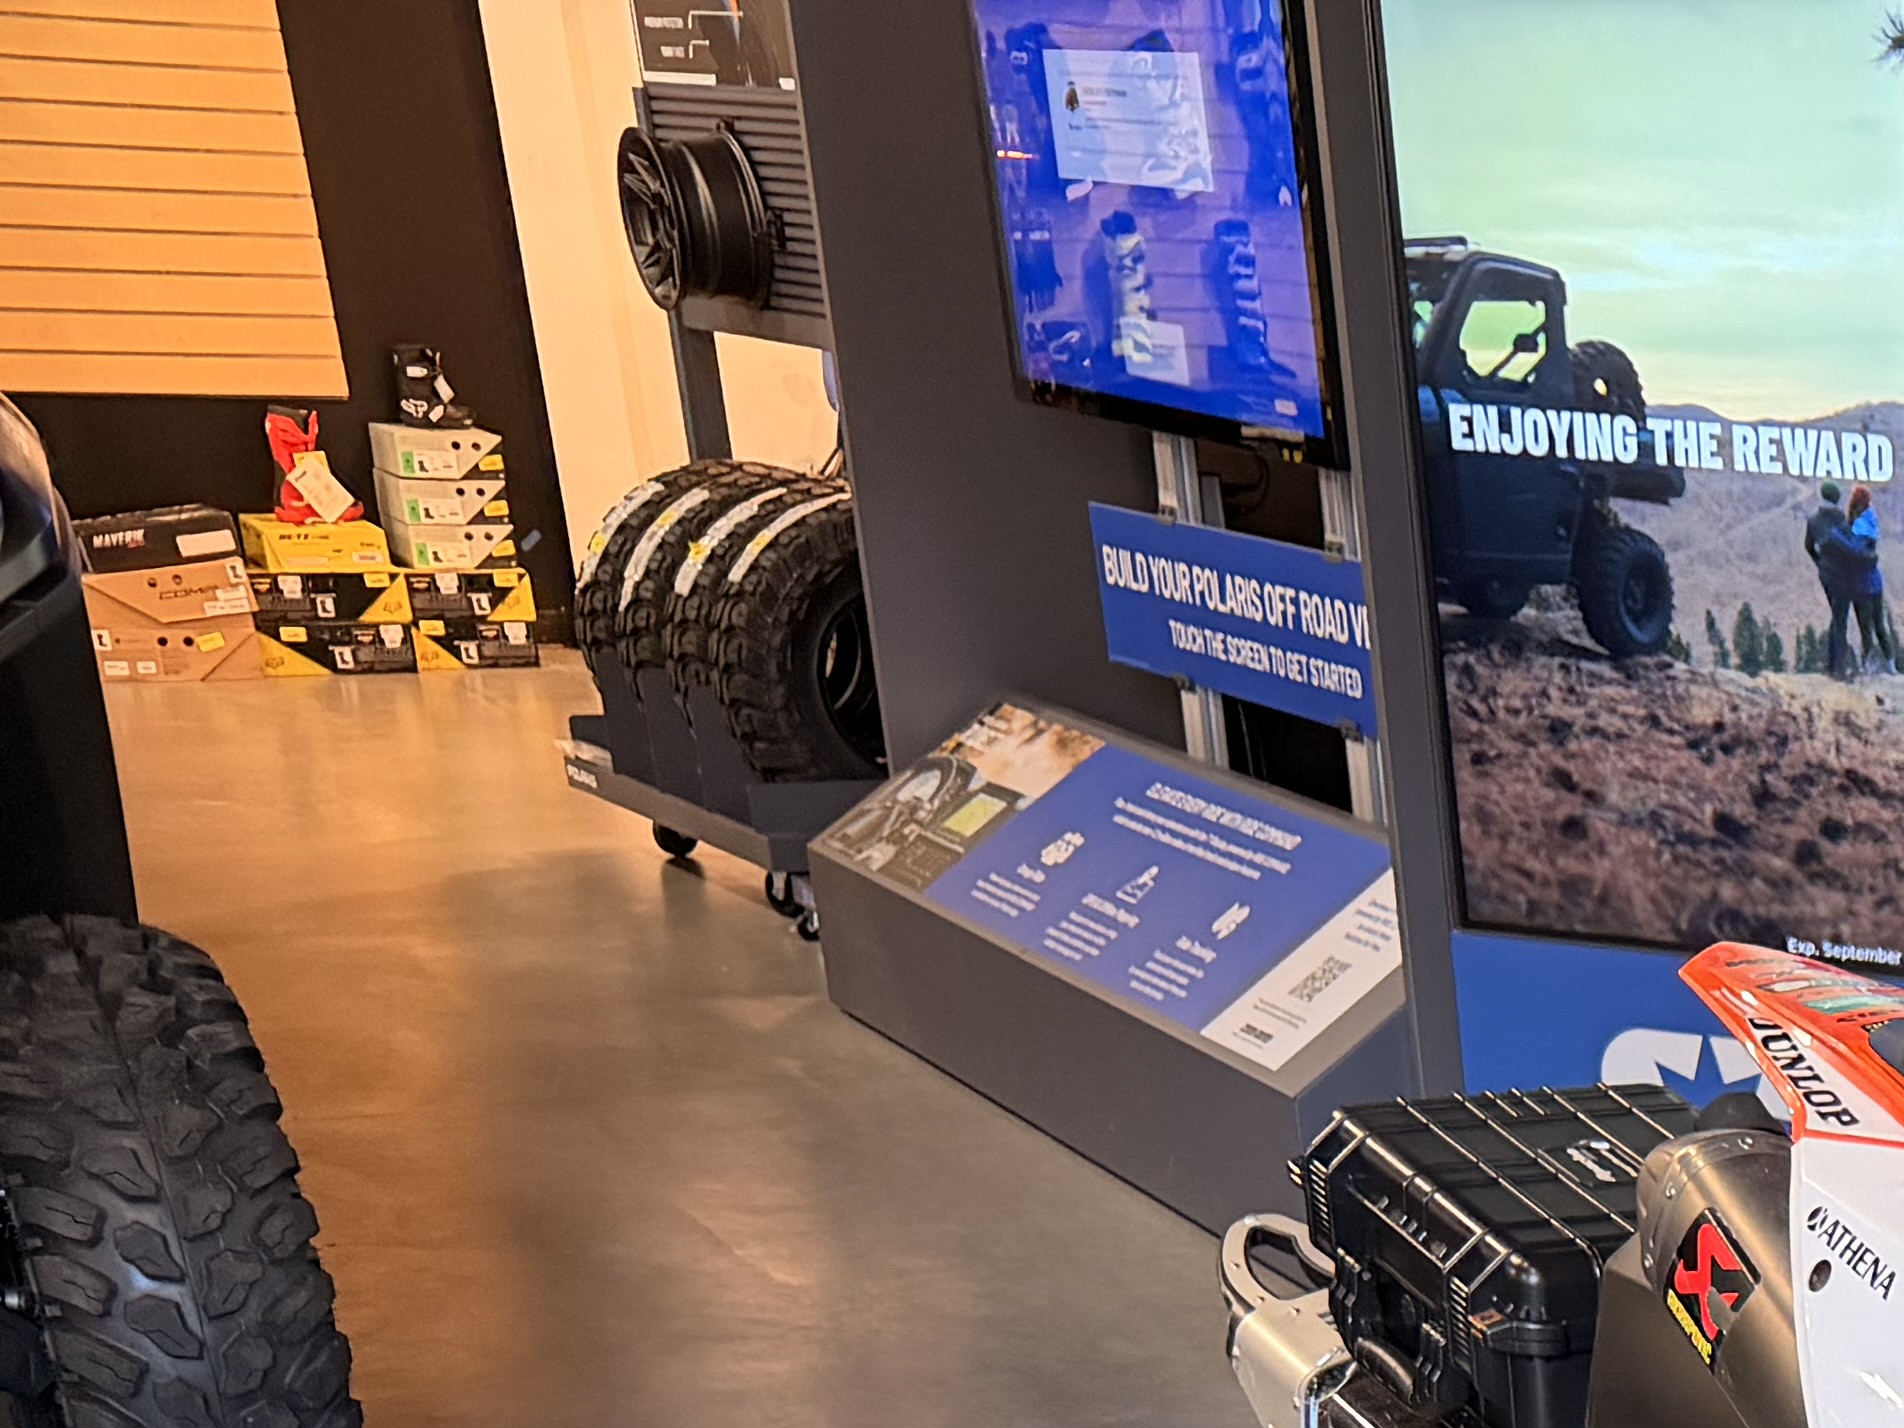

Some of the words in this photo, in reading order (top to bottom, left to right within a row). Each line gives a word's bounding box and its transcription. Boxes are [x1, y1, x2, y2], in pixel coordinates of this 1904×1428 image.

[1448, 402, 1638, 464] ENJOYING
[1645, 417, 1724, 470] THE
[1731, 423, 1895, 482] REWARD
[1102, 544, 1149, 593] BUILD
[1148, 554, 1194, 605] YOUR
[1191, 565, 1263, 623] POLARIS
[1262, 581, 1297, 631] OFF
[1298, 590, 1349, 645] ROAD
[1168, 618, 1204, 656] TOUCH
[1203, 629, 1228, 662] THE
[1226, 634, 1271, 674] SCREEN
[1268, 645, 1287, 679] TO
[1286, 650, 1309, 685] GET
[1308, 656, 1363, 700] STARTED
[1785, 935, 1821, 957] Exp.
[1821, 940, 1903, 967] September
[1820, 1217, 1898, 1302] ATHENA
